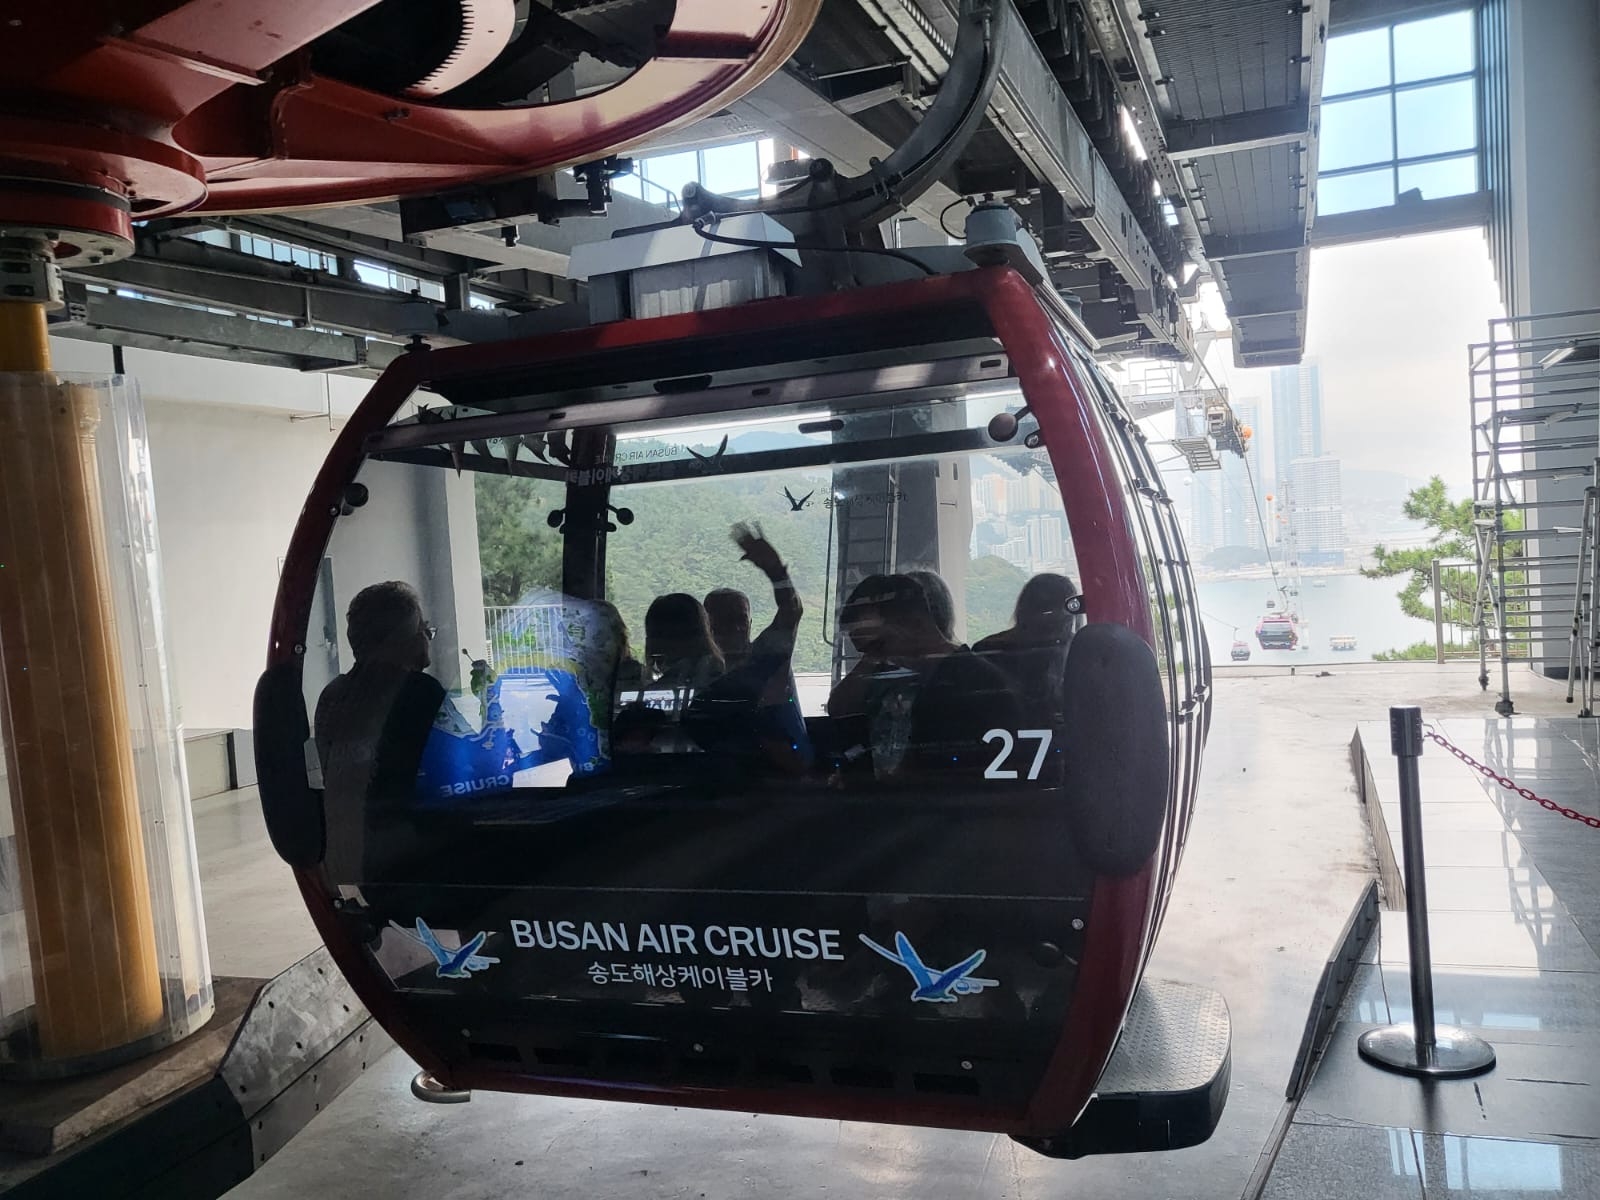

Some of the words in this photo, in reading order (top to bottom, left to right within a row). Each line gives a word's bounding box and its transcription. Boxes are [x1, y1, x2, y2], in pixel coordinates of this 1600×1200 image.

[982, 728, 1053, 780] 27
[510, 919, 631, 952] BUSAN
[637, 923, 699, 955] AIR
[703, 925, 845, 961] CRUISE
[587, 961, 774, 993] 송도해상케이블카
